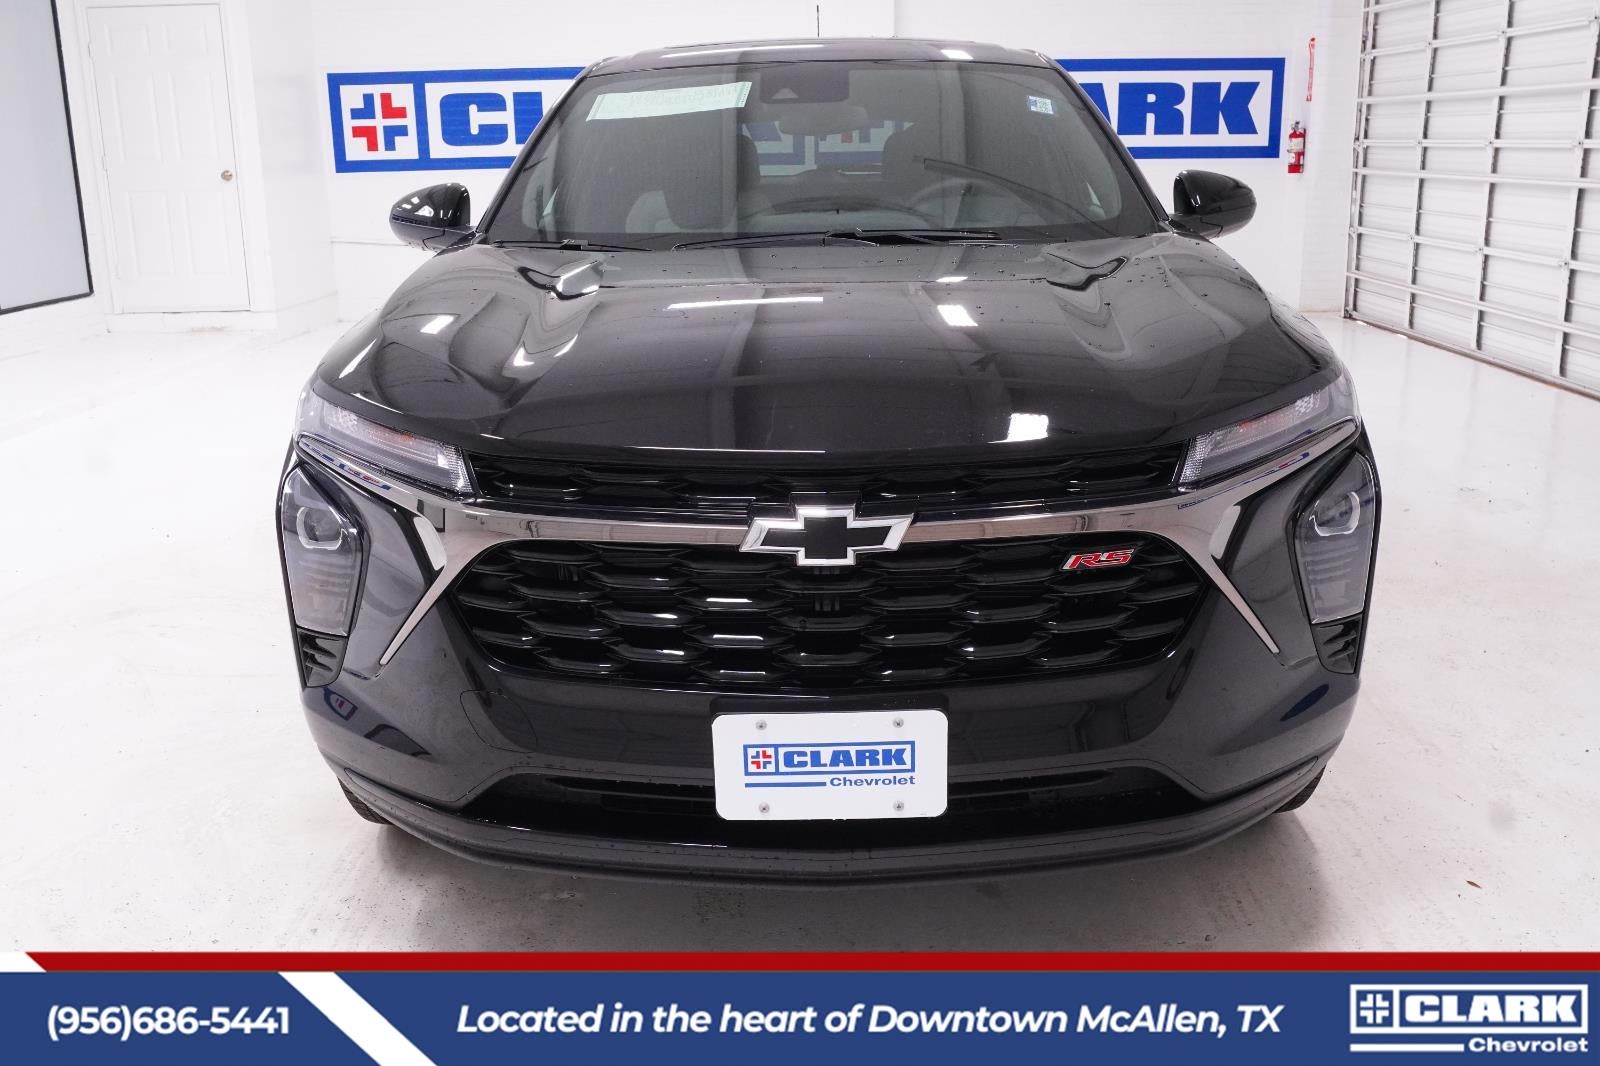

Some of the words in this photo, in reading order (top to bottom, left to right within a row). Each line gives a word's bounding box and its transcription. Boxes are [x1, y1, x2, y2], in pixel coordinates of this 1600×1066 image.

[1062, 548, 1135, 570] RS
[783, 748, 907, 769] CLARK
[829, 775, 916, 788] Chevrolet
